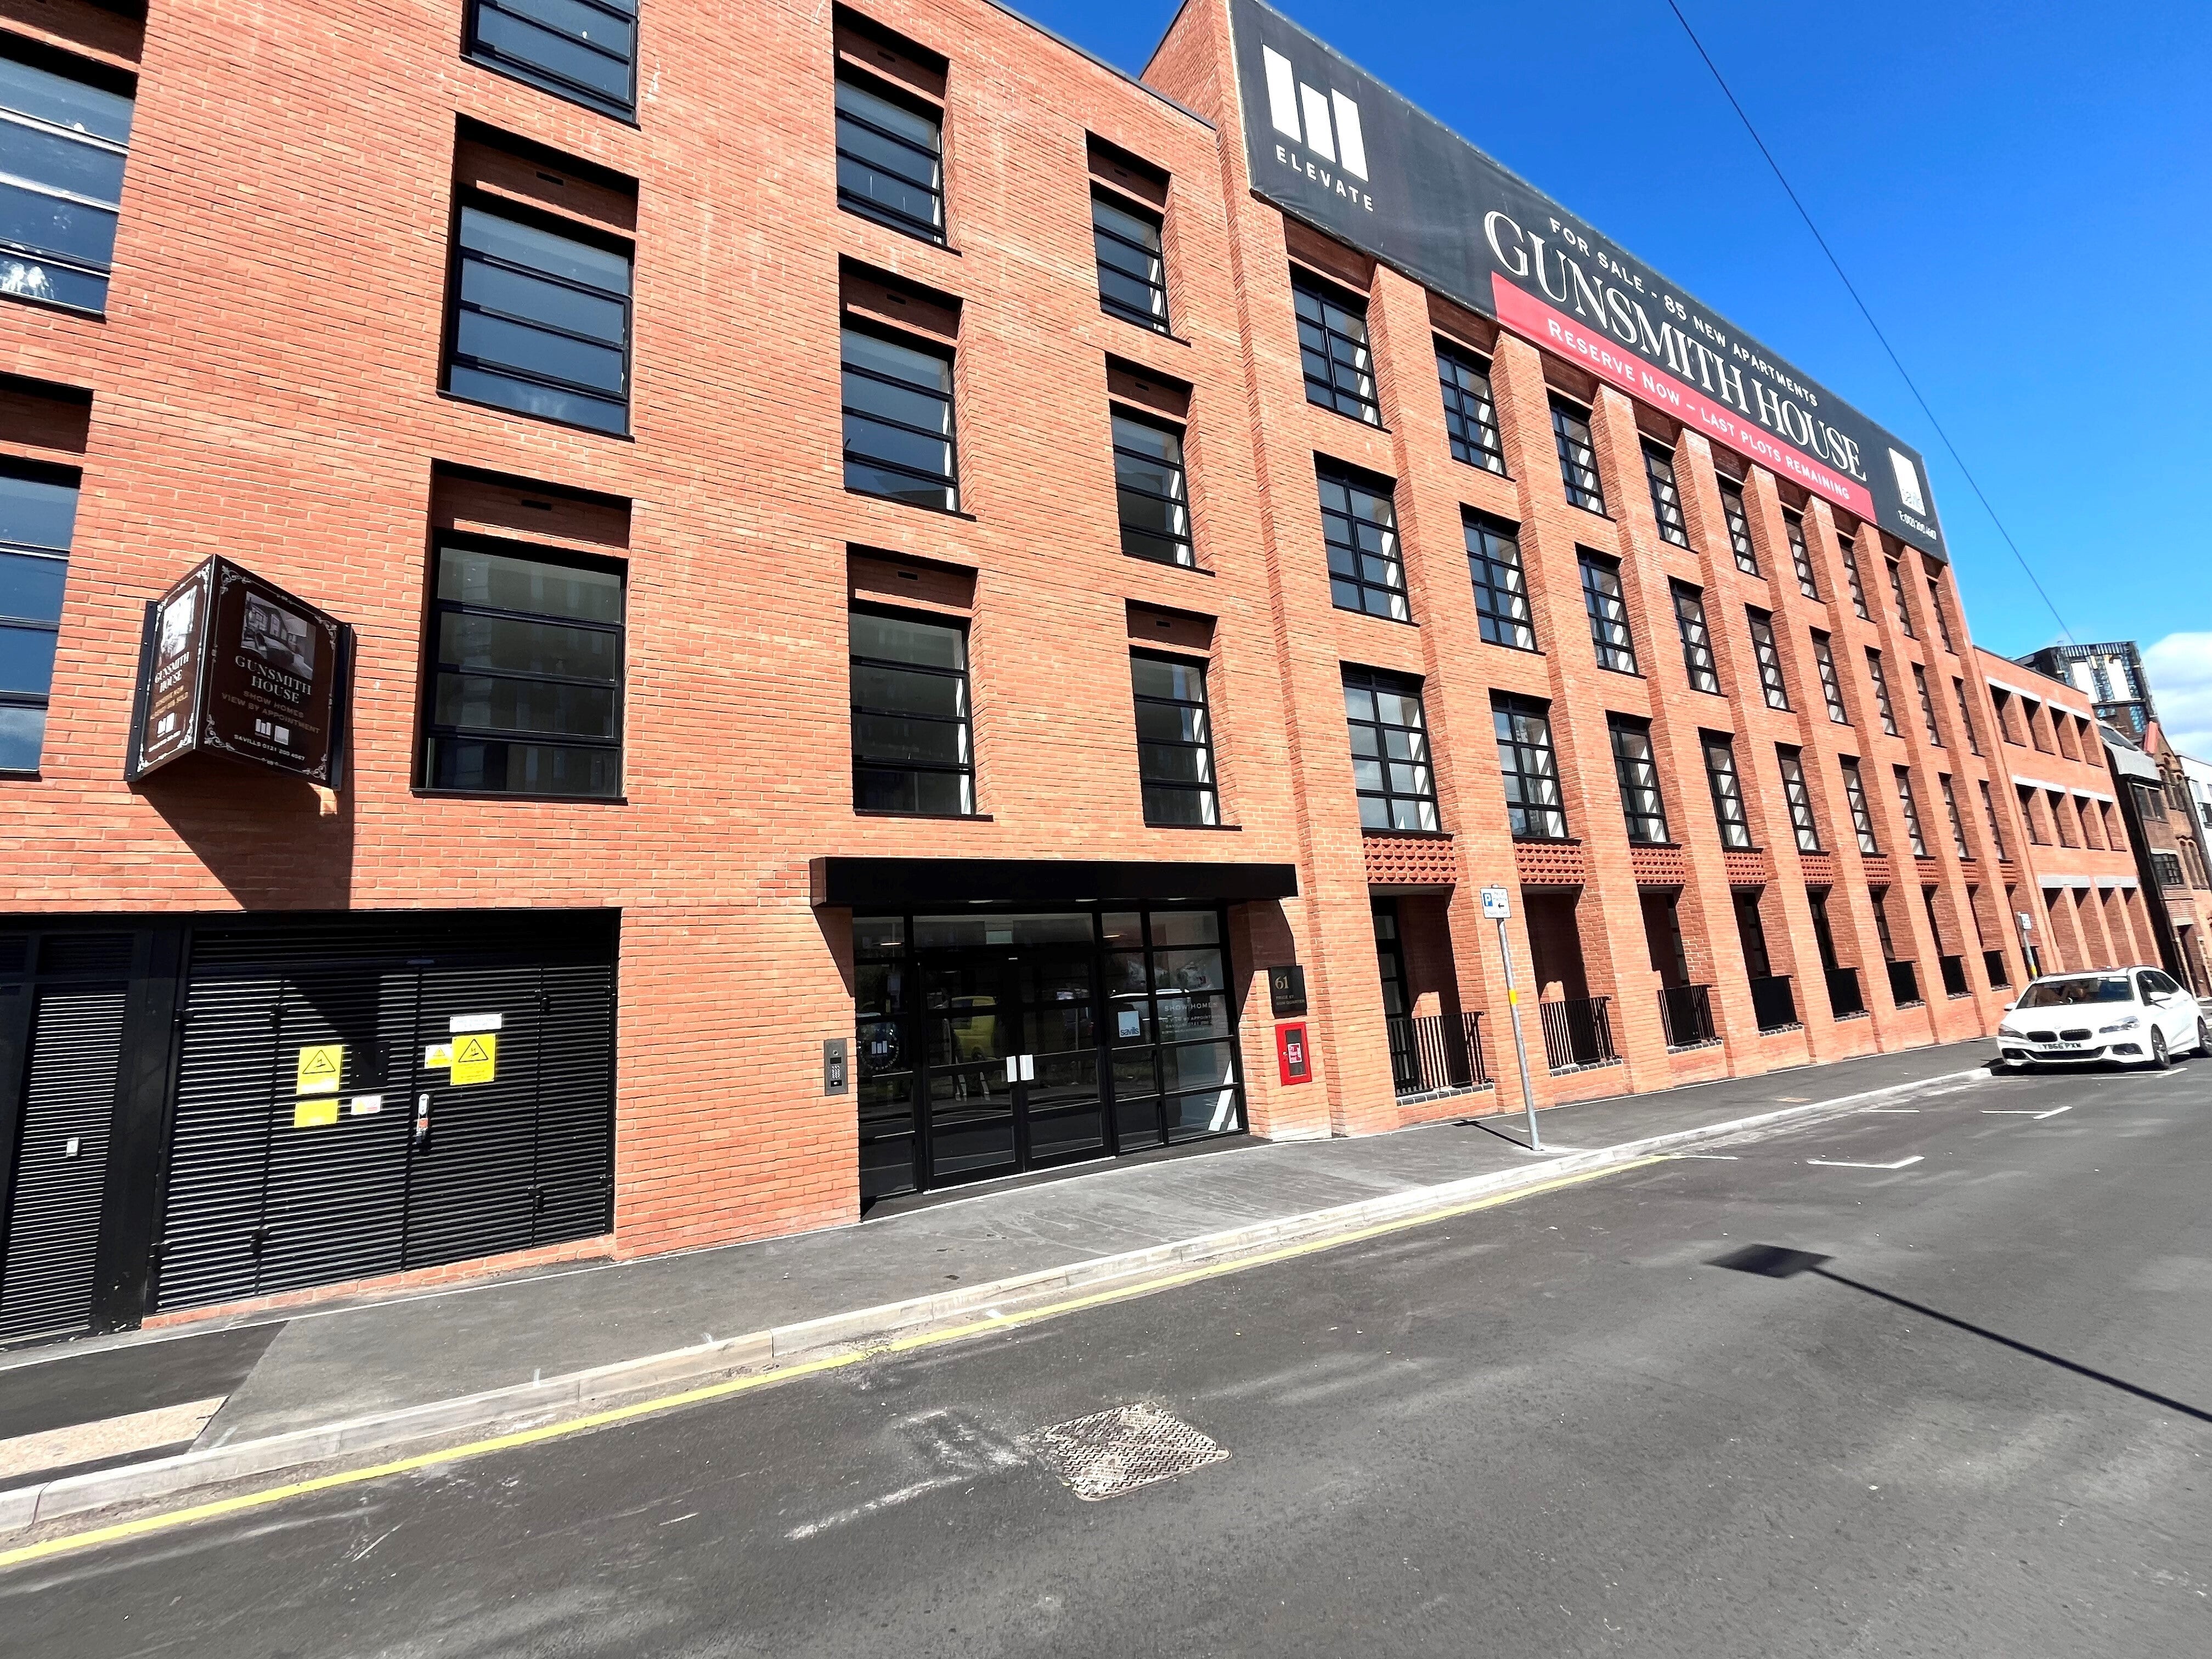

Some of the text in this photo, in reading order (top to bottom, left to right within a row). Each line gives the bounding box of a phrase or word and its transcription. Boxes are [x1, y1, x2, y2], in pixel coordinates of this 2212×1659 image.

[1276, 144, 1374, 212] ELEVATE
[1549, 217, 1590, 257] FOR
[1597, 251, 1645, 294] SALE
[1663, 294, 1687, 321] 85
[1692, 315, 1726, 348] NEW
[1733, 343, 1818, 407] APARTMENTS
[1484, 211, 1867, 482] GUNSMITH HOUSE
[1547, 318, 1636, 382] RESERVE
[1641, 371, 1680, 407] NOW
[1701, 407, 1735, 437] LAST
[1740, 430, 1782, 463] PLOTS
[1785, 455, 1850, 500] REMAINING
[235, 655, 312, 695] GUNSMITH
[251, 675, 300, 704] HOUSE
[222, 692, 320, 734] VIEW BY APPOINTMENT
[243, 690, 304, 718] SHOW HOMES
[234, 734, 261, 747] SAVILLS
[262, 743, 277, 752] 0121
[1274, 975, 1289, 990] 61
